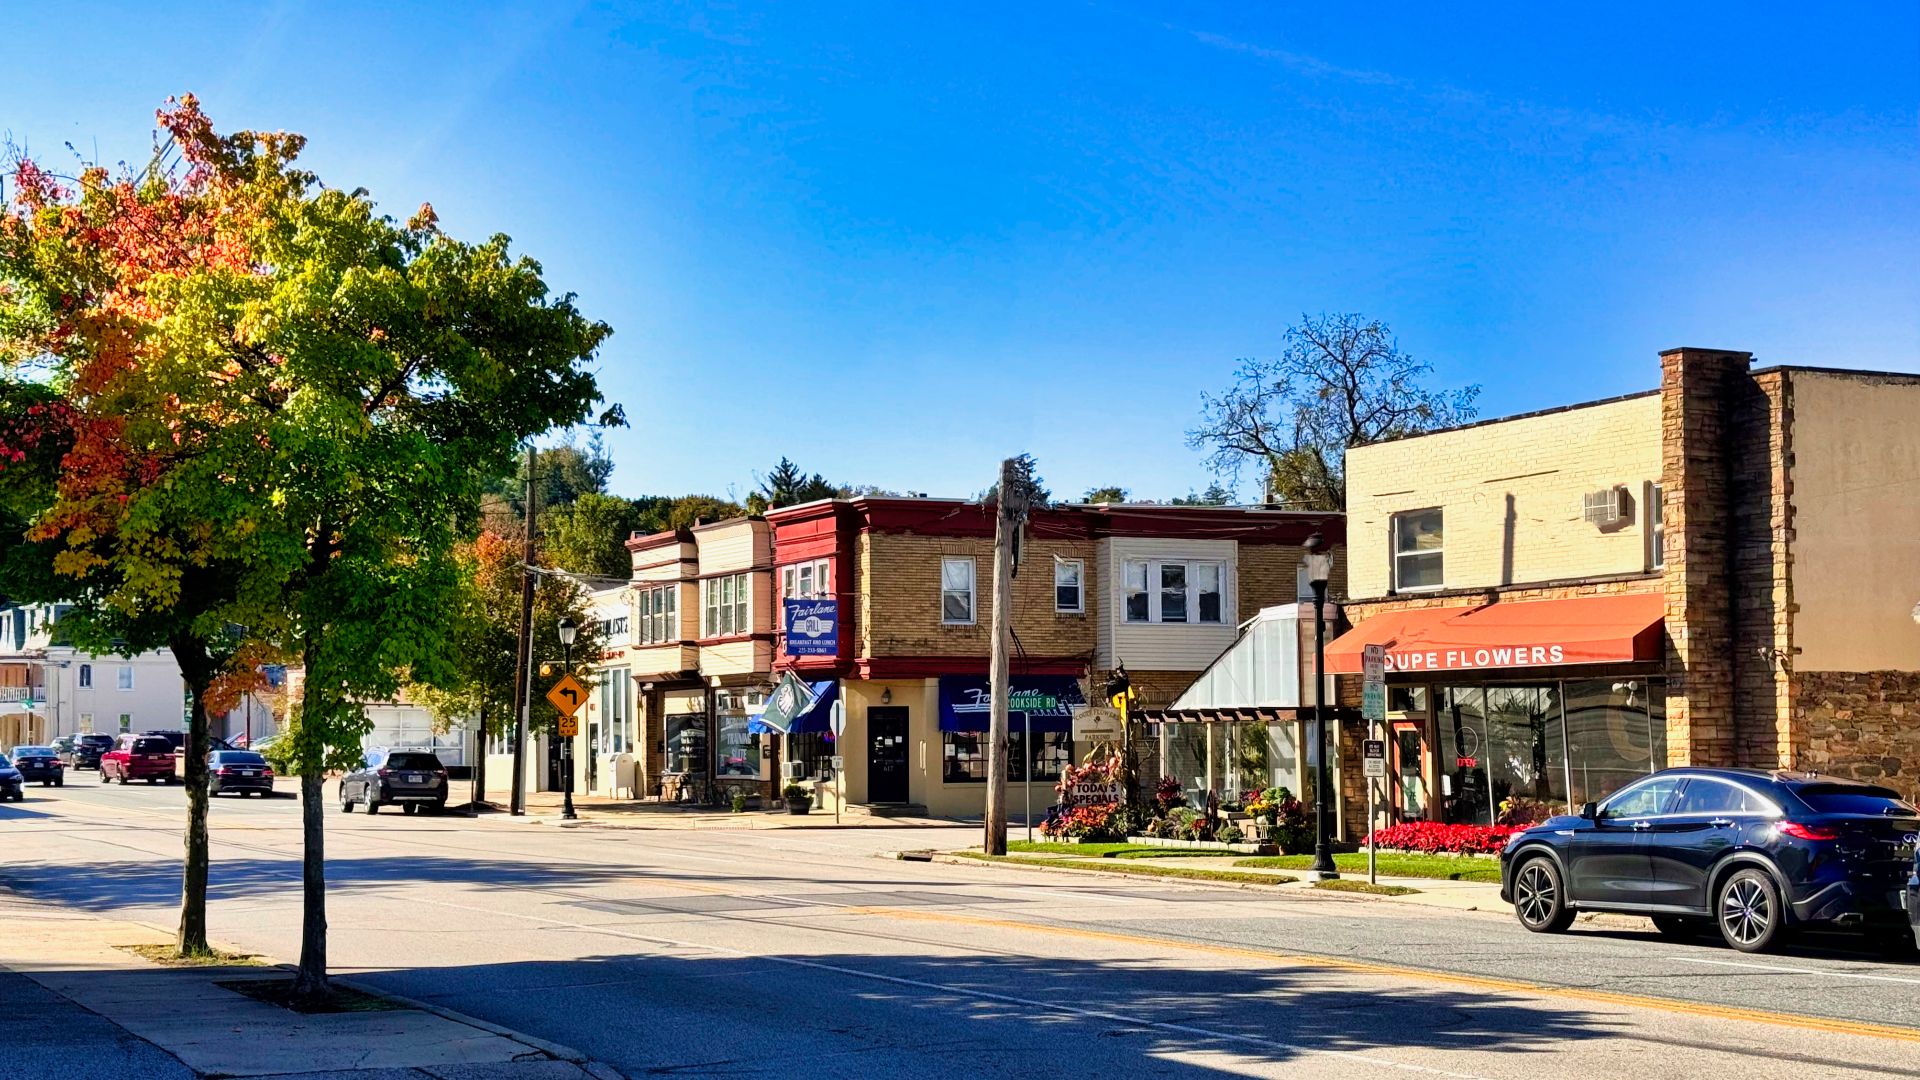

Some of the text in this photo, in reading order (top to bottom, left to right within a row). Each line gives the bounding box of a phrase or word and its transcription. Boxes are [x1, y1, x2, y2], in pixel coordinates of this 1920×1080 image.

[788, 602, 836, 621] Fairlane
[806, 619, 819, 632] GRILL
[1371, 646, 1379, 655] NO
[1384, 645, 1565, 670] OUPE FLOWERS
[1046, 697, 1056, 708] RD
[562, 717, 576, 728] 25
[1456, 758, 1477, 768] OPEN
[1077, 784, 1117, 793] TODAY'S
[1073, 794, 1119, 804] SPECIALS
